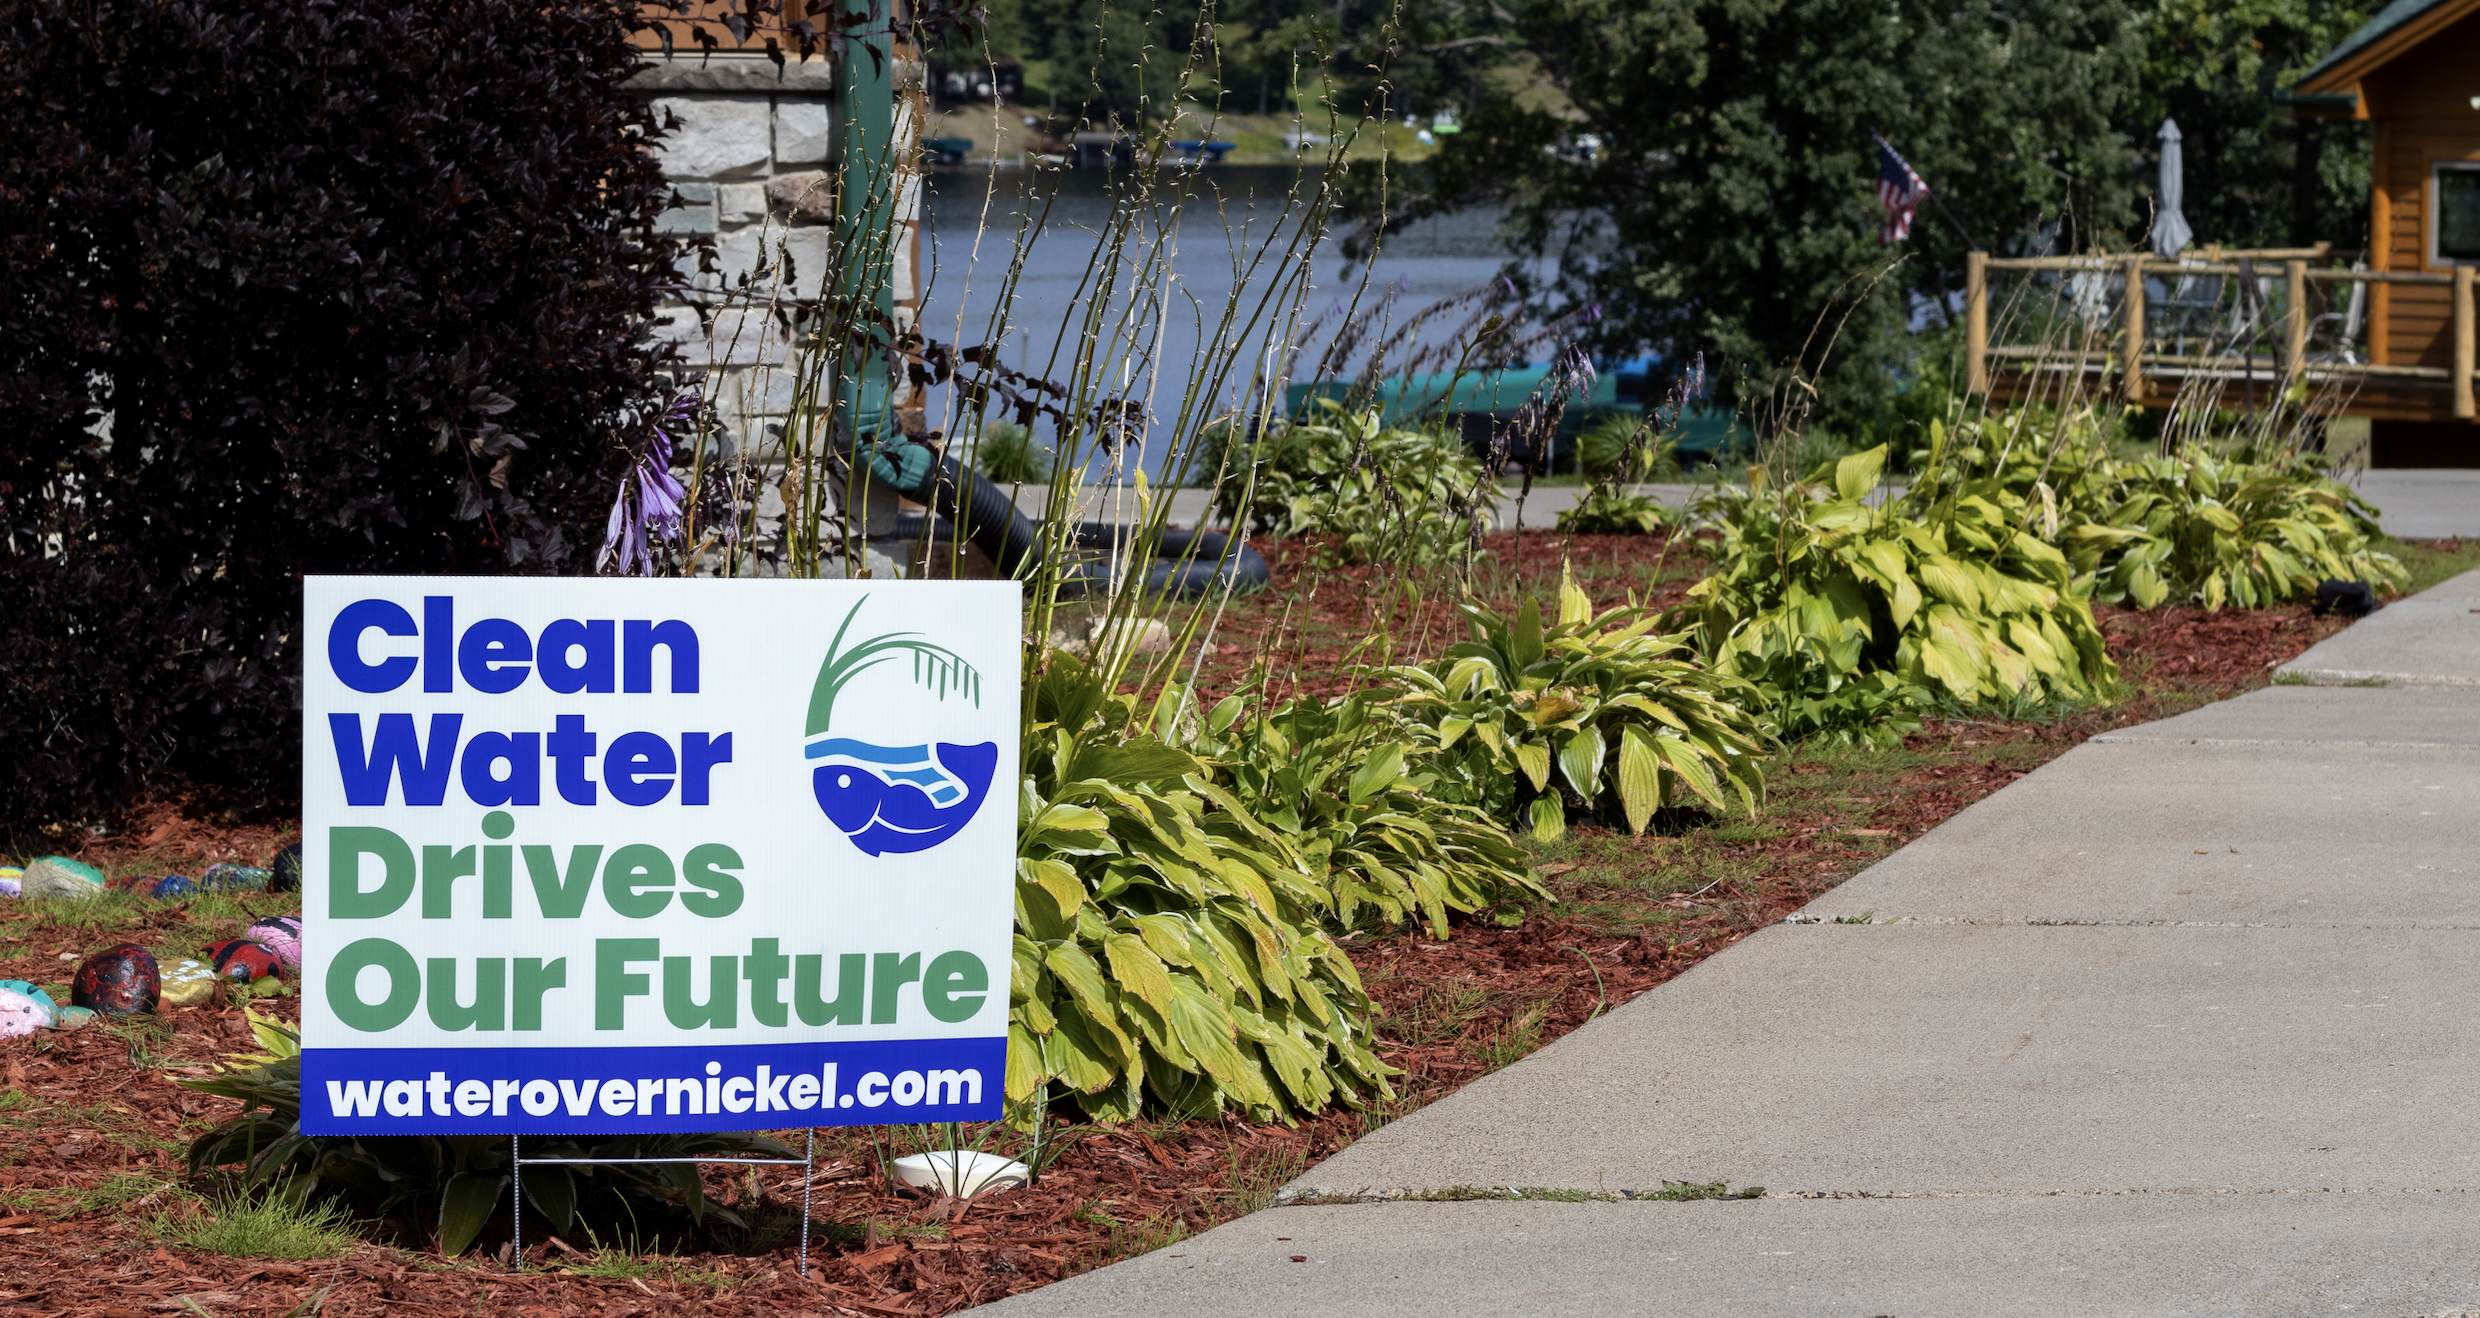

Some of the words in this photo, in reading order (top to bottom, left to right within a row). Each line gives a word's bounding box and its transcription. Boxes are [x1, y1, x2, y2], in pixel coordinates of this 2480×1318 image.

[328, 596, 700, 694] Clean
[328, 713, 733, 807] Water
[329, 811, 745, 919] Drives
[326, 938, 567, 1032] Our
[595, 938, 989, 1030] Future
[326, 1061, 983, 1118] waterovernickel.com
